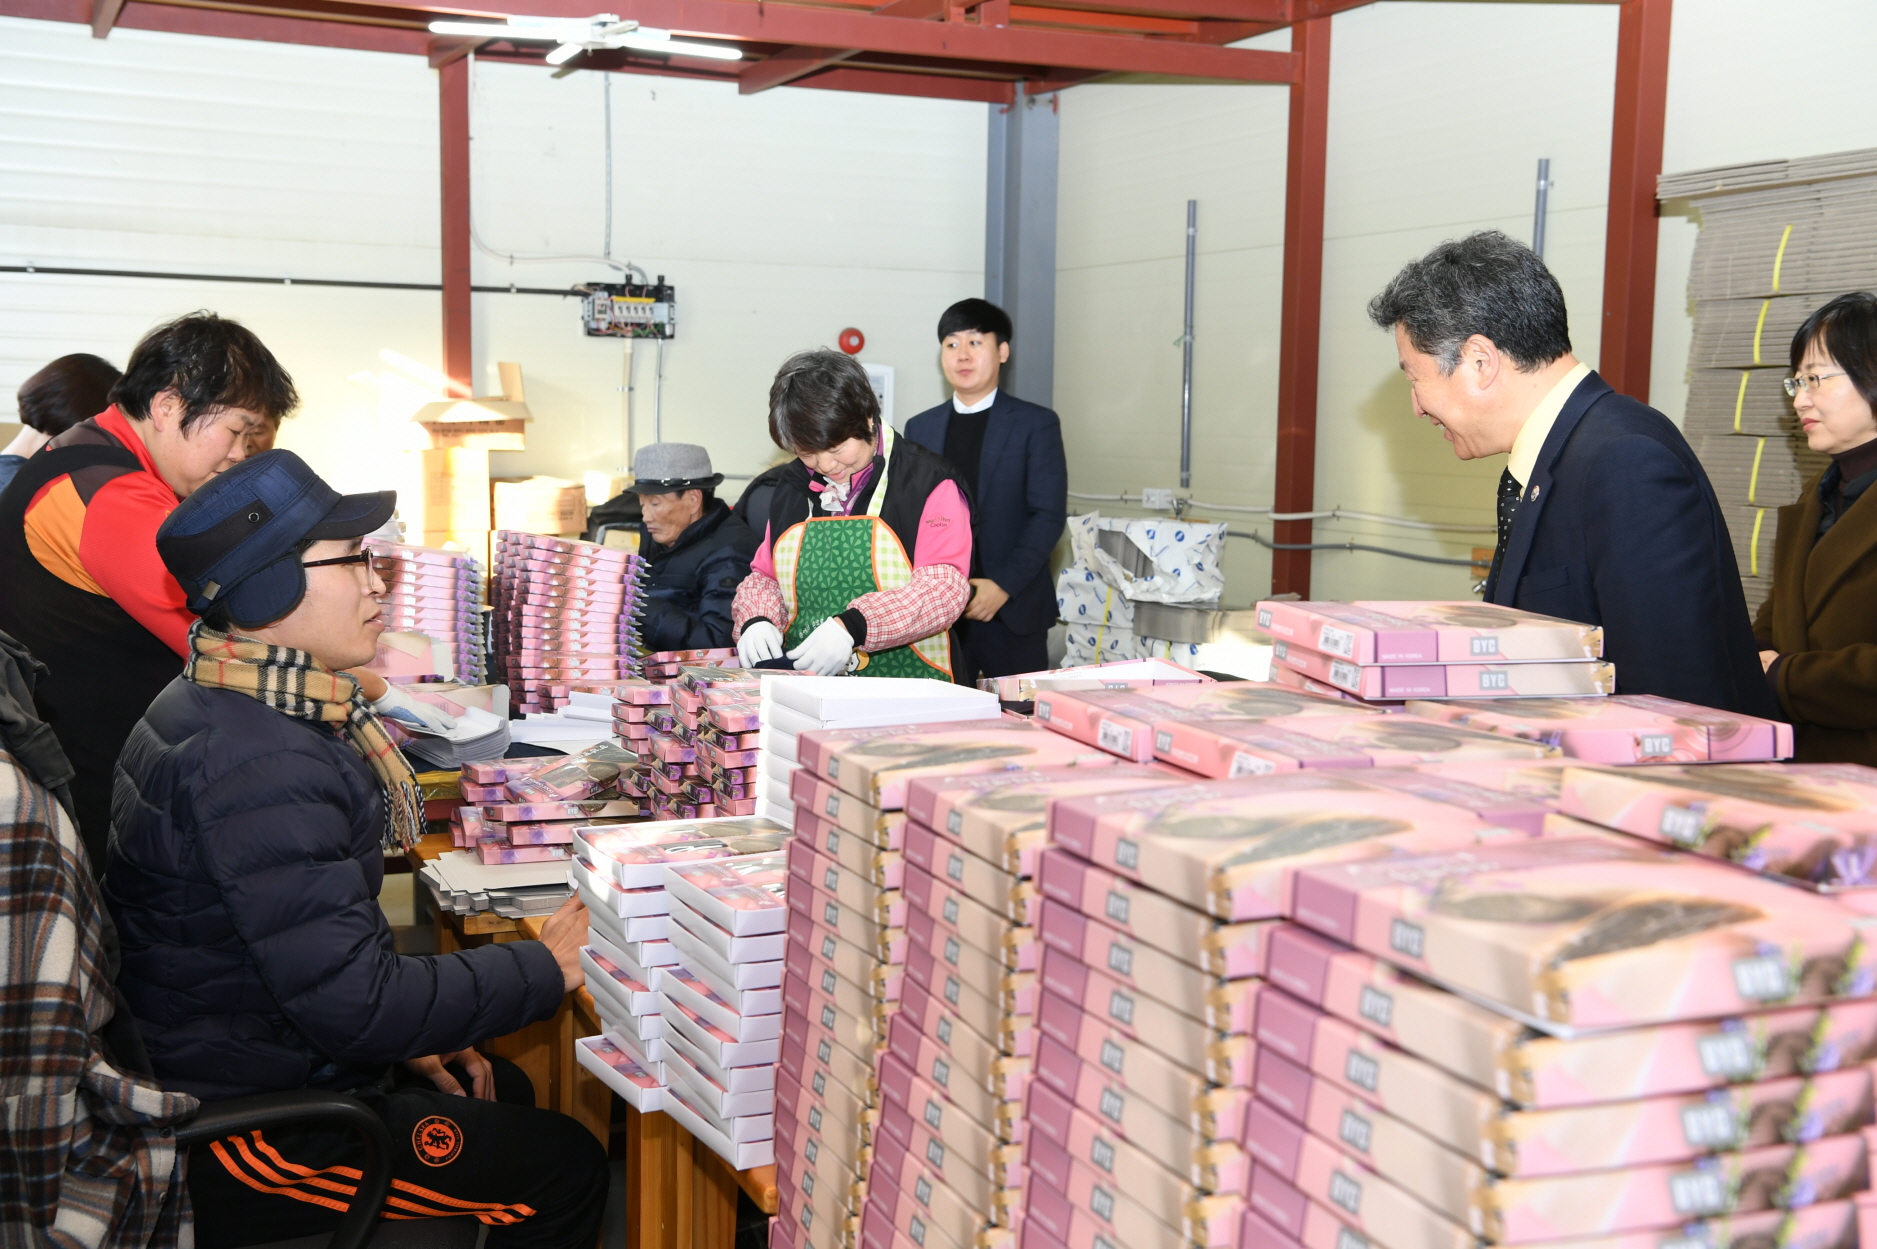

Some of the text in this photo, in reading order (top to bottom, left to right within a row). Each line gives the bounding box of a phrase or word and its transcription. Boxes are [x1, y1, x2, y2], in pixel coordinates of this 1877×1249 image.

[1473, 639, 1496, 653] BYC
[1482, 674, 1505, 688] BYC
[1644, 738, 1671, 753] BYC
[416, 1122, 429, 1151] CHELSEA
